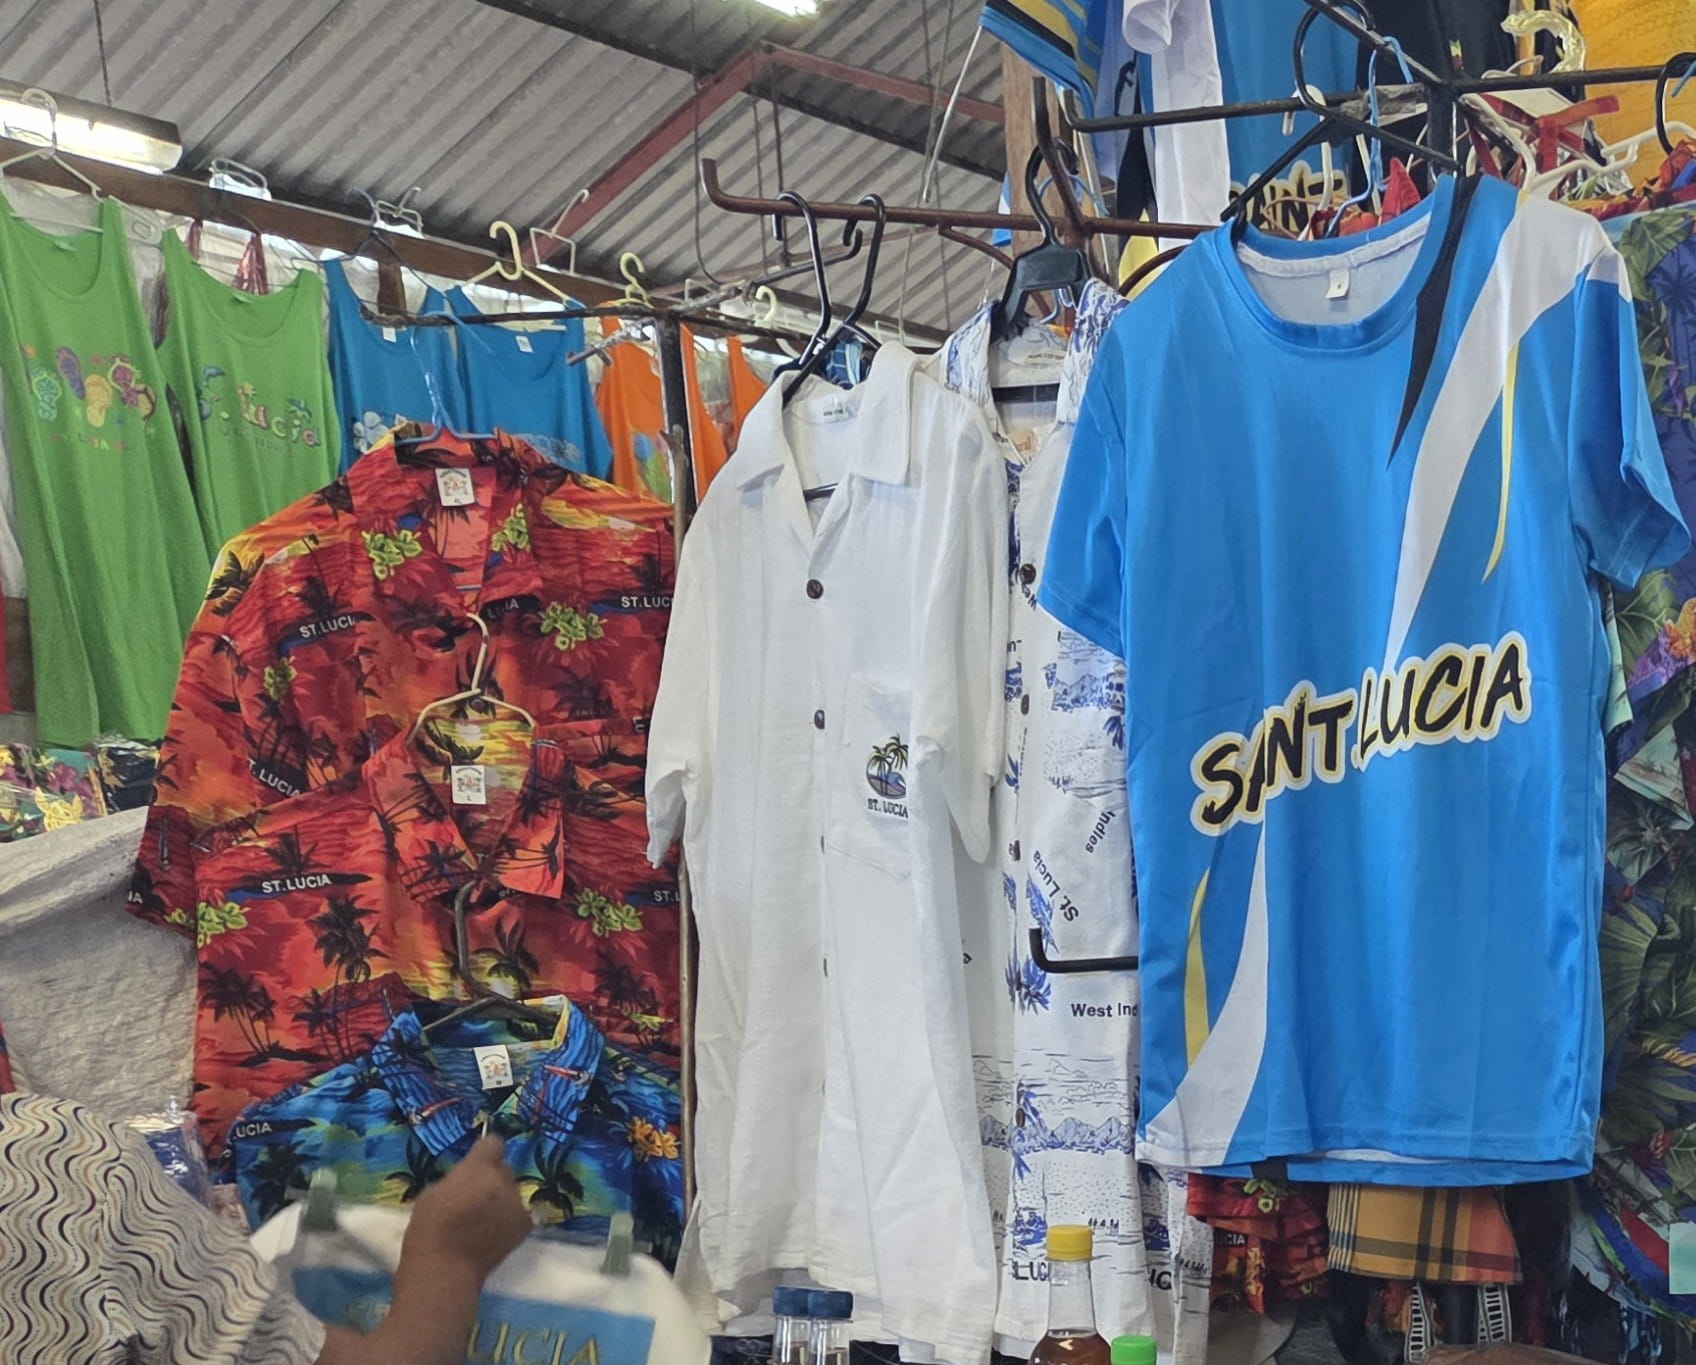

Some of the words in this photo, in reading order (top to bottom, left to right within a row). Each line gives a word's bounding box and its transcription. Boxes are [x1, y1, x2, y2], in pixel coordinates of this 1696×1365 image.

[1360, 642, 1524, 761] LUCIA
[883, 802, 908, 819] LUCIA
[1032, 850, 1060, 897] Lucia
[1071, 1002, 1113, 1019] West
[232, 1121, 273, 1139] UCIA
